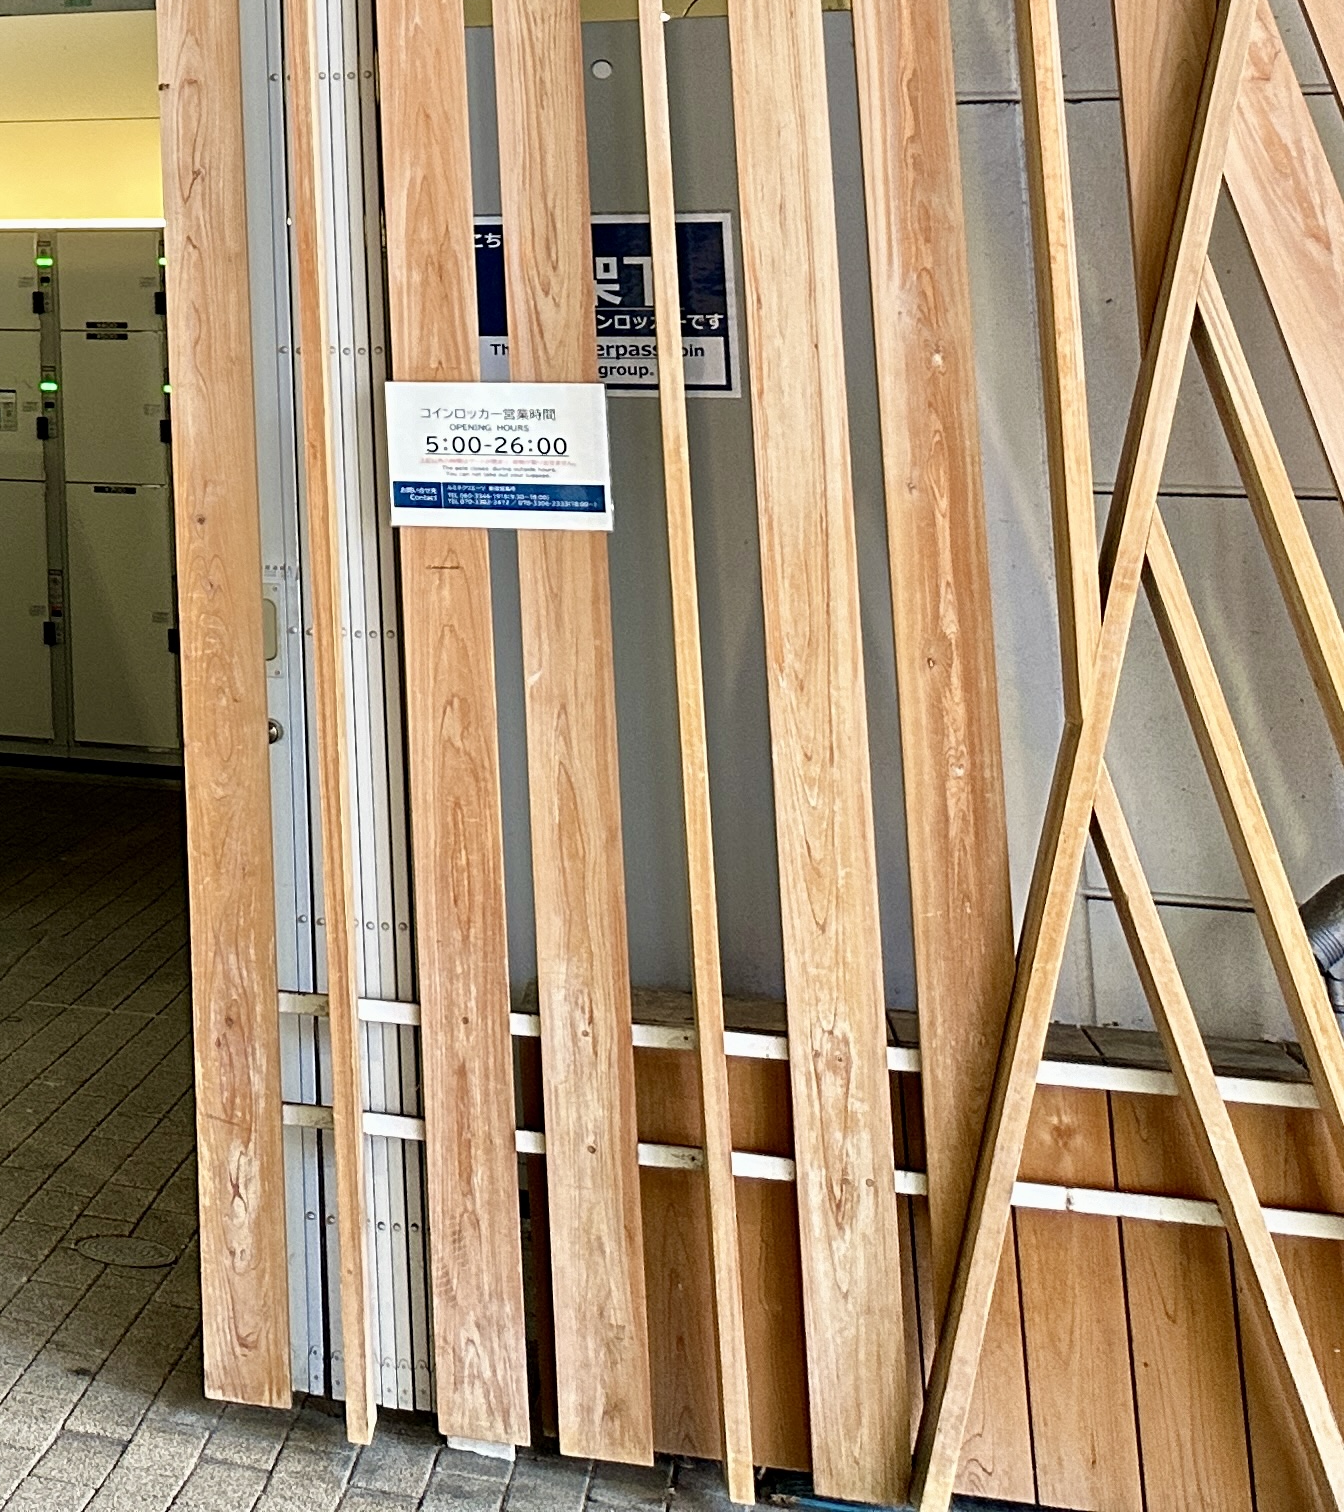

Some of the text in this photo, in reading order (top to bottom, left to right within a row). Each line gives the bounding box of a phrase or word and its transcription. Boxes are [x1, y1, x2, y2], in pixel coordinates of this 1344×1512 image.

[597, 344, 658, 360] erpass
[682, 344, 705, 357] oin
[598, 365, 655, 379] group.
[419, 407, 556, 421] コインロッカー営業時間
[449, 423, 530, 432] OPENING HOURS
[425, 435, 568, 455] 5:00-26:00
